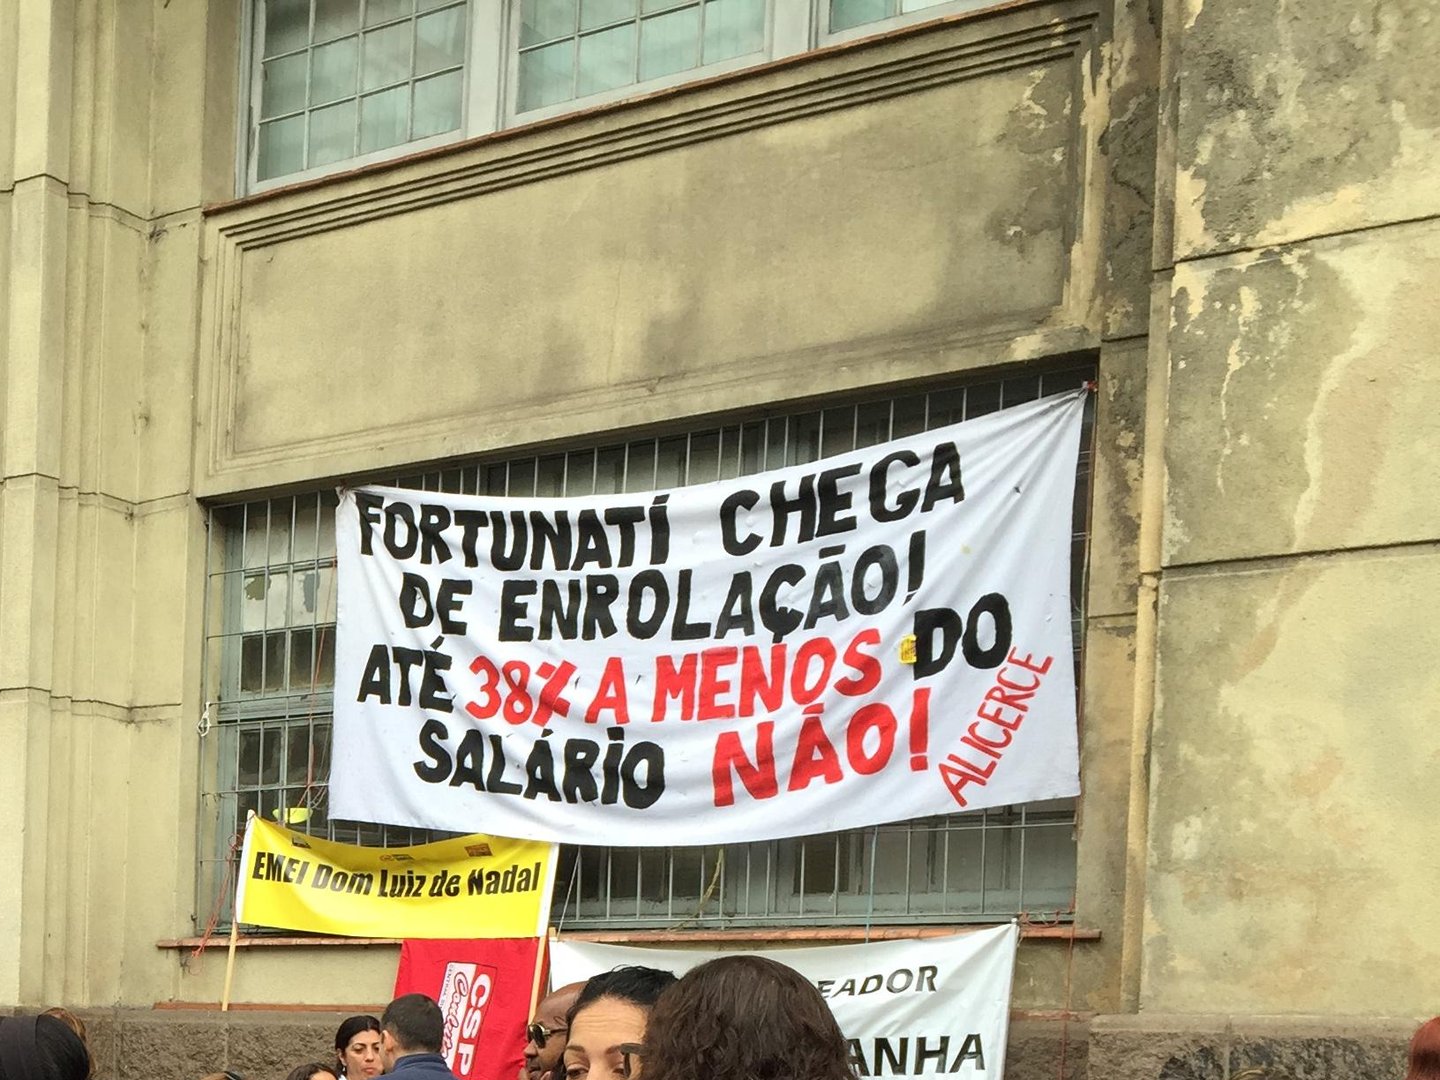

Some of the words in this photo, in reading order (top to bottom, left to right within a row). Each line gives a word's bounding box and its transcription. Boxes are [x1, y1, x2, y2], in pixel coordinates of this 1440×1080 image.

[720, 441, 965, 556] CHEGA
[399, 572, 472, 635] DE
[499, 530, 926, 643] ENROLAÇÃO!
[357, 636, 453, 713] ATÉ
[465, 655, 578, 727] 38%
[585, 657, 630, 724] A
[651, 628, 882, 723] MENOS
[913, 592, 1012, 680] DO
[413, 718, 665, 809] SALÁRIO
[938, 647, 1054, 807] ALICERCE
[252, 851, 311, 885] EMEI
[311, 864, 374, 896] Dom
[377, 869, 429, 897] Luiz
[429, 870, 461, 897] de
[467, 862, 542, 896] Nadal
[458, 973, 492, 1076] CSP
[817, 965, 939, 999] EADOR
[846, 1033, 986, 1078] ANHA
